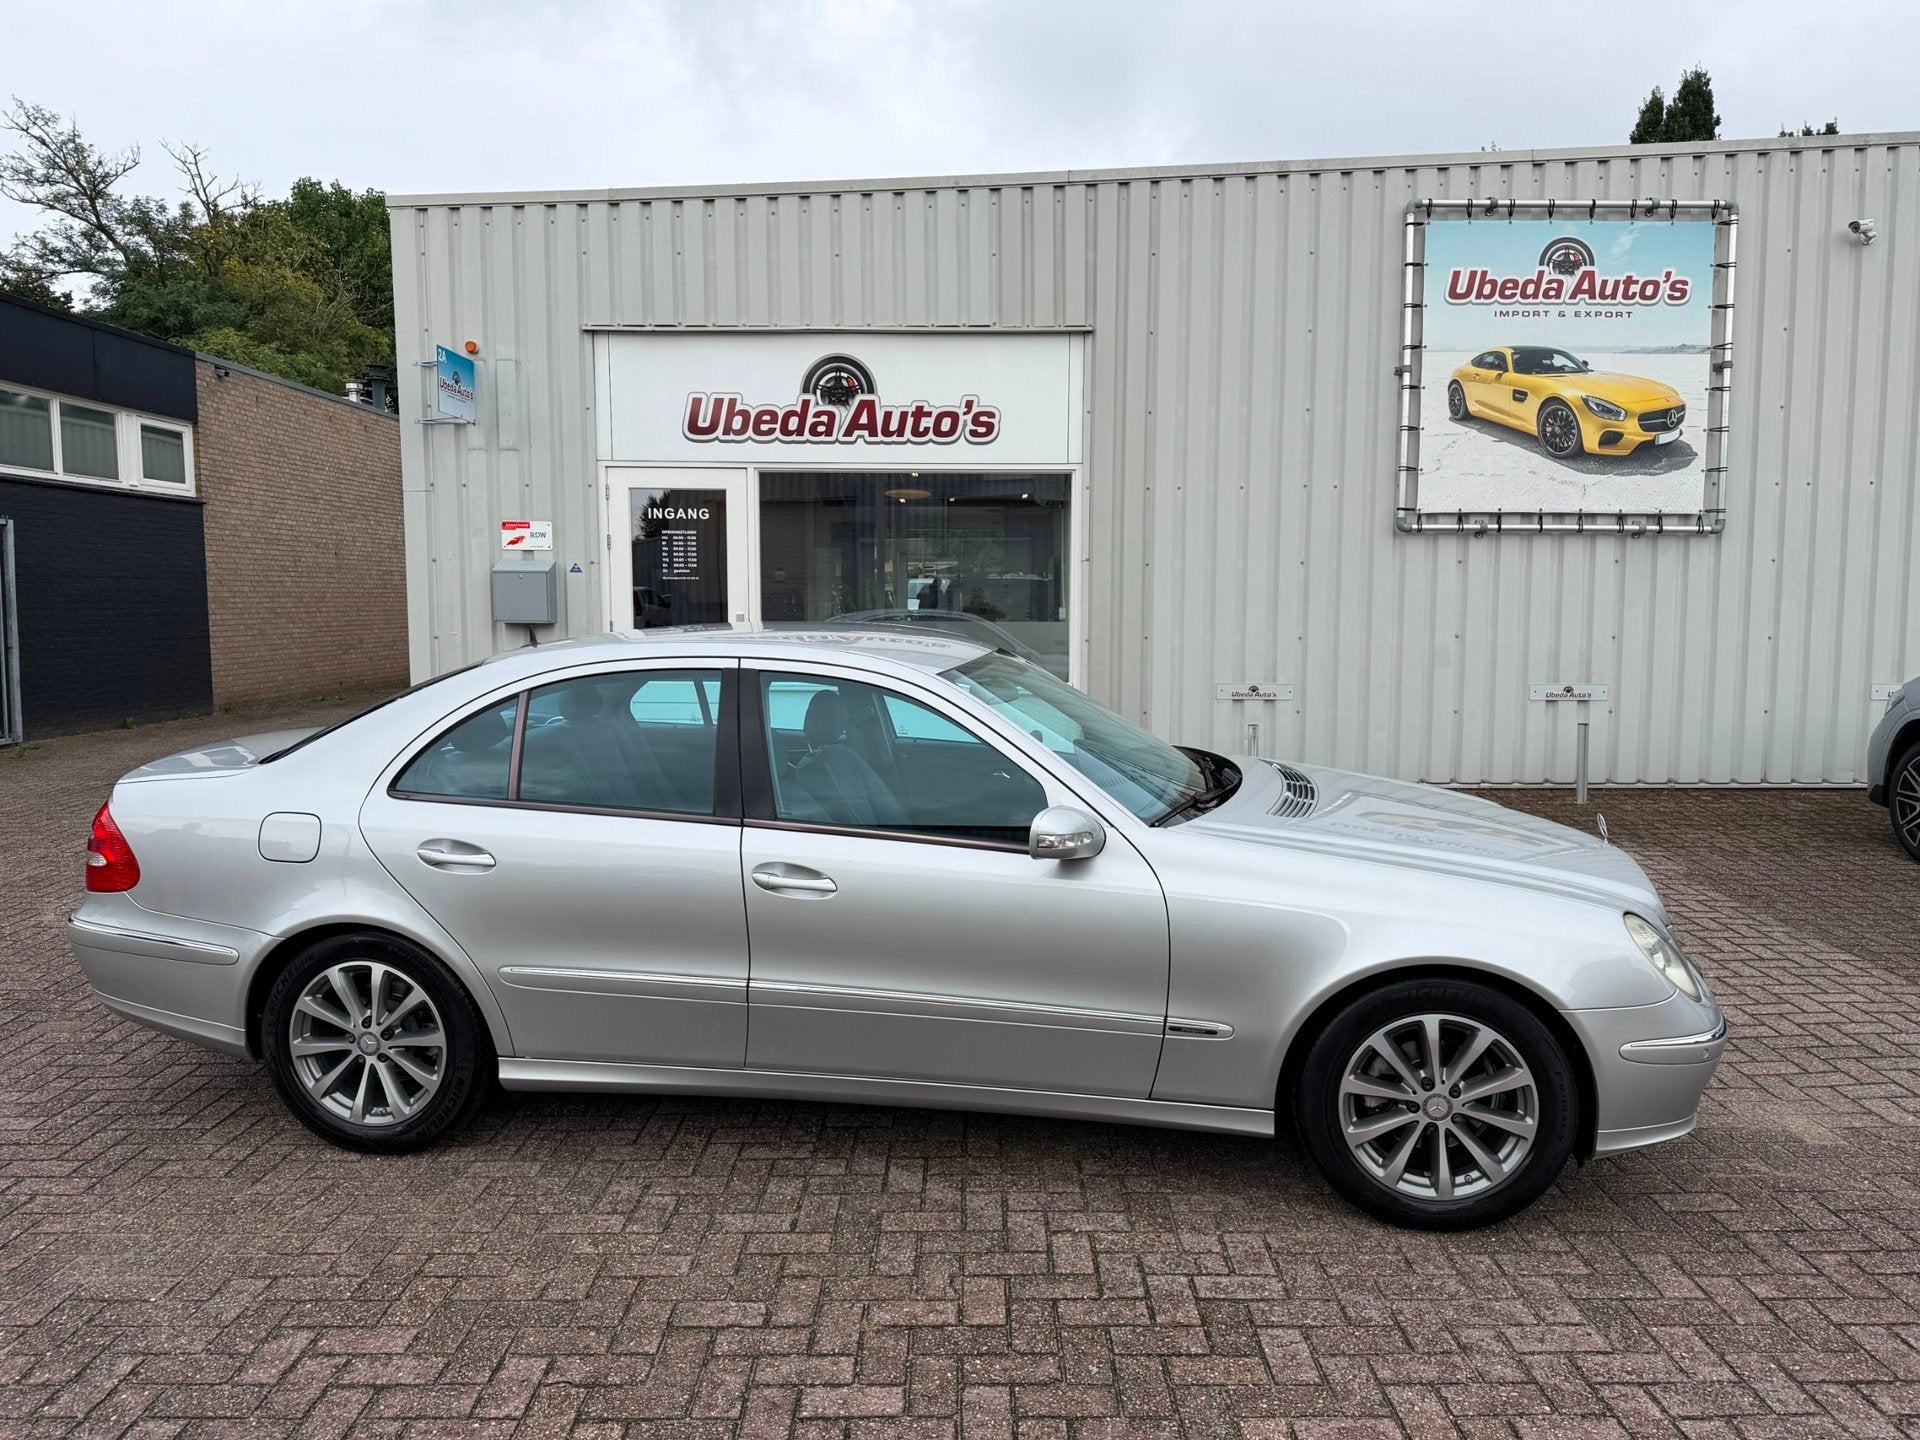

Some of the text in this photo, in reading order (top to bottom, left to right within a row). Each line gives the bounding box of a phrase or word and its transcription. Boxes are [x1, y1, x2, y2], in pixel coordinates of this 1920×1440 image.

[1447, 269, 1689, 302] Ubeda Auto's
[1494, 310, 1634, 319] IMPORT & EXPORT
[438, 348, 447, 364] 2A
[685, 393, 997, 439] Ubeda Auto's
[648, 507, 710, 520] INGANG
[529, 531, 547, 539] RDW
